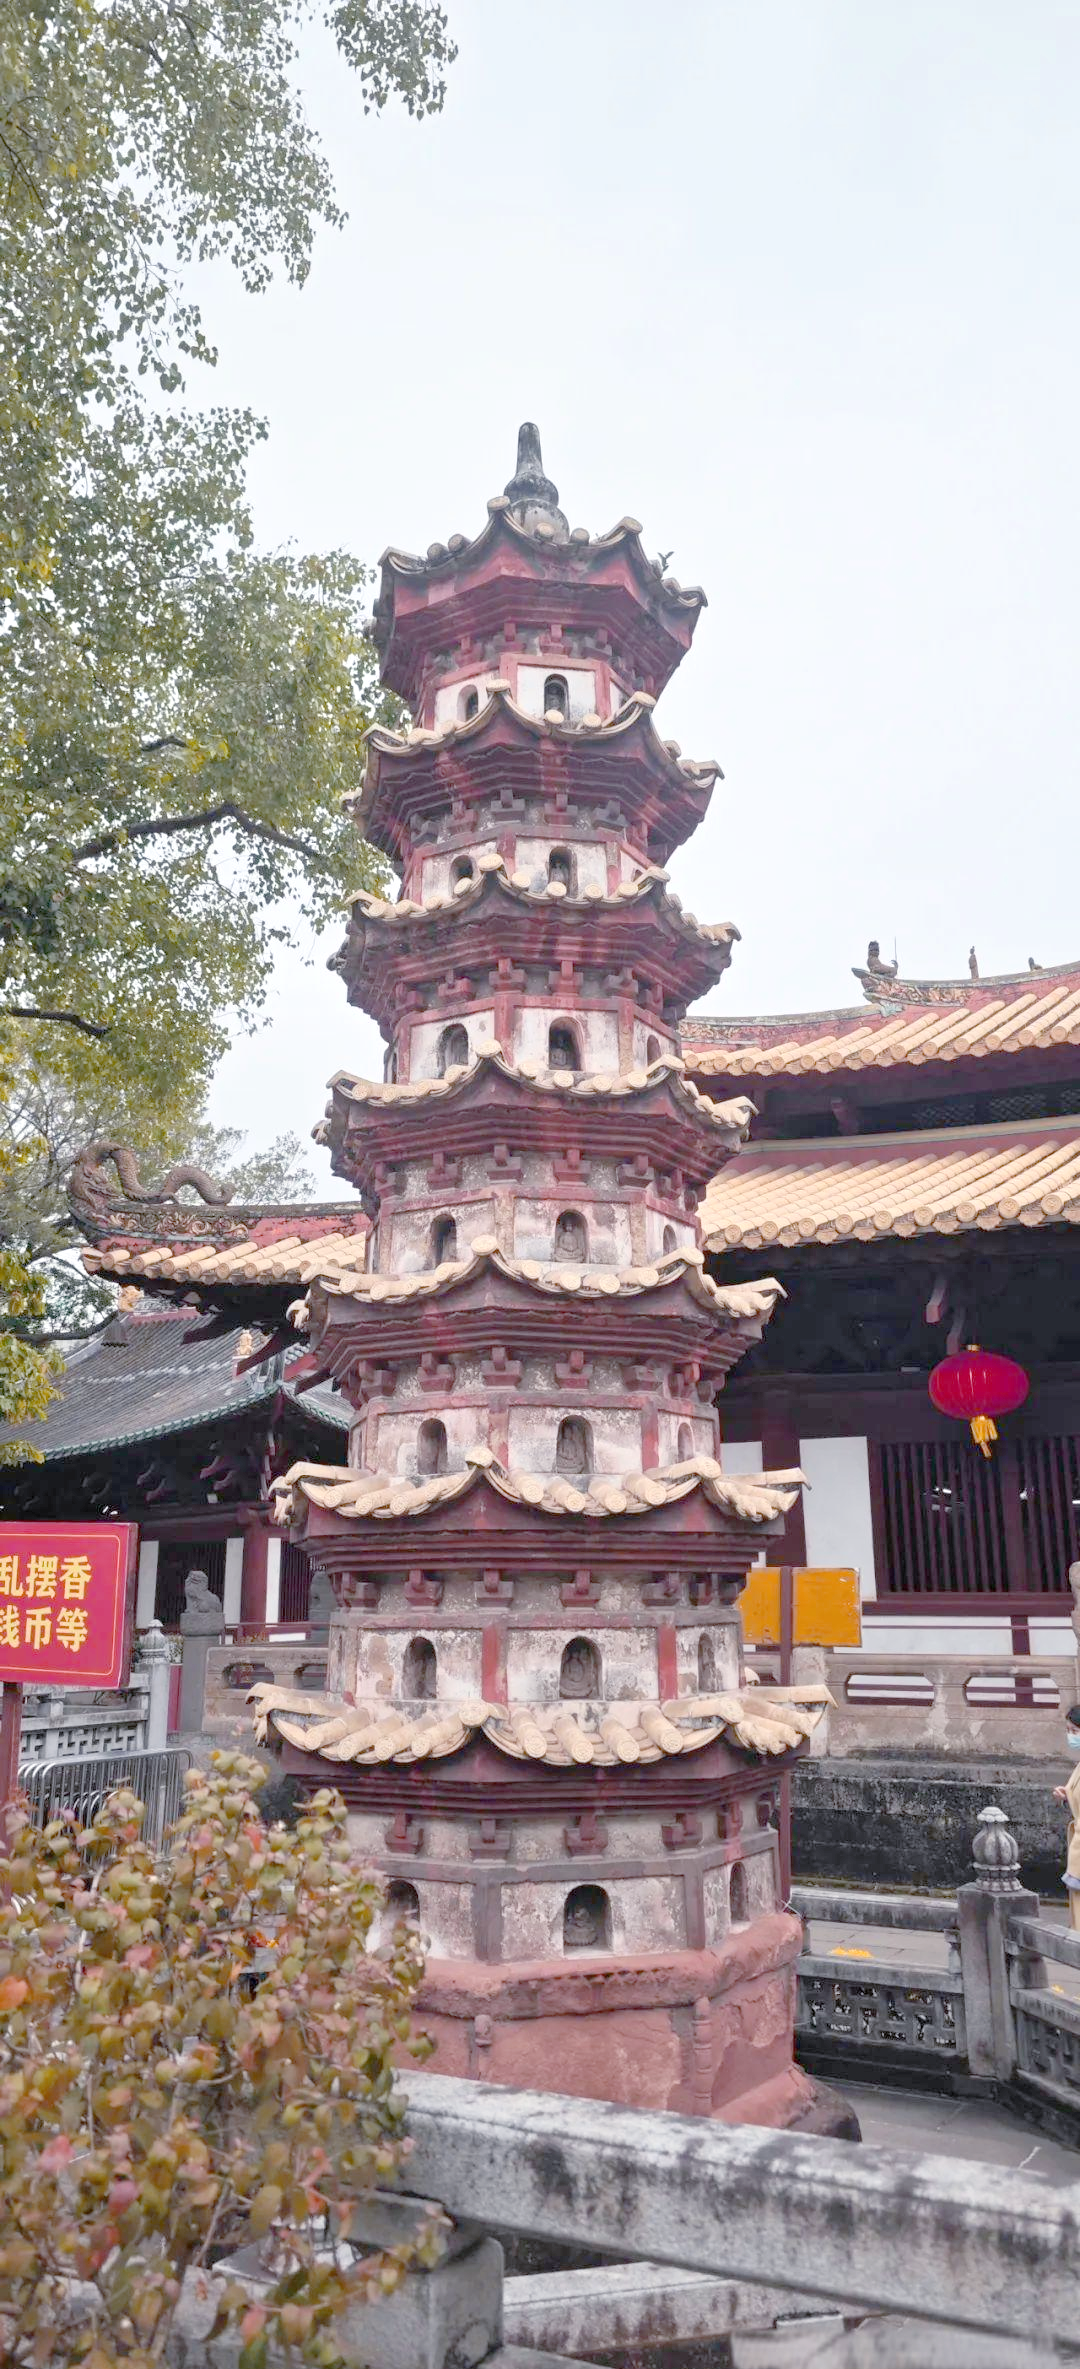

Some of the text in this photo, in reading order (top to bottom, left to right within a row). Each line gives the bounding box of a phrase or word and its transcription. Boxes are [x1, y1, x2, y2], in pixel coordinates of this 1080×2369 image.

[0, 1555, 92, 1600] 乱摆香
[0, 1605, 89, 1653] 钱币等
